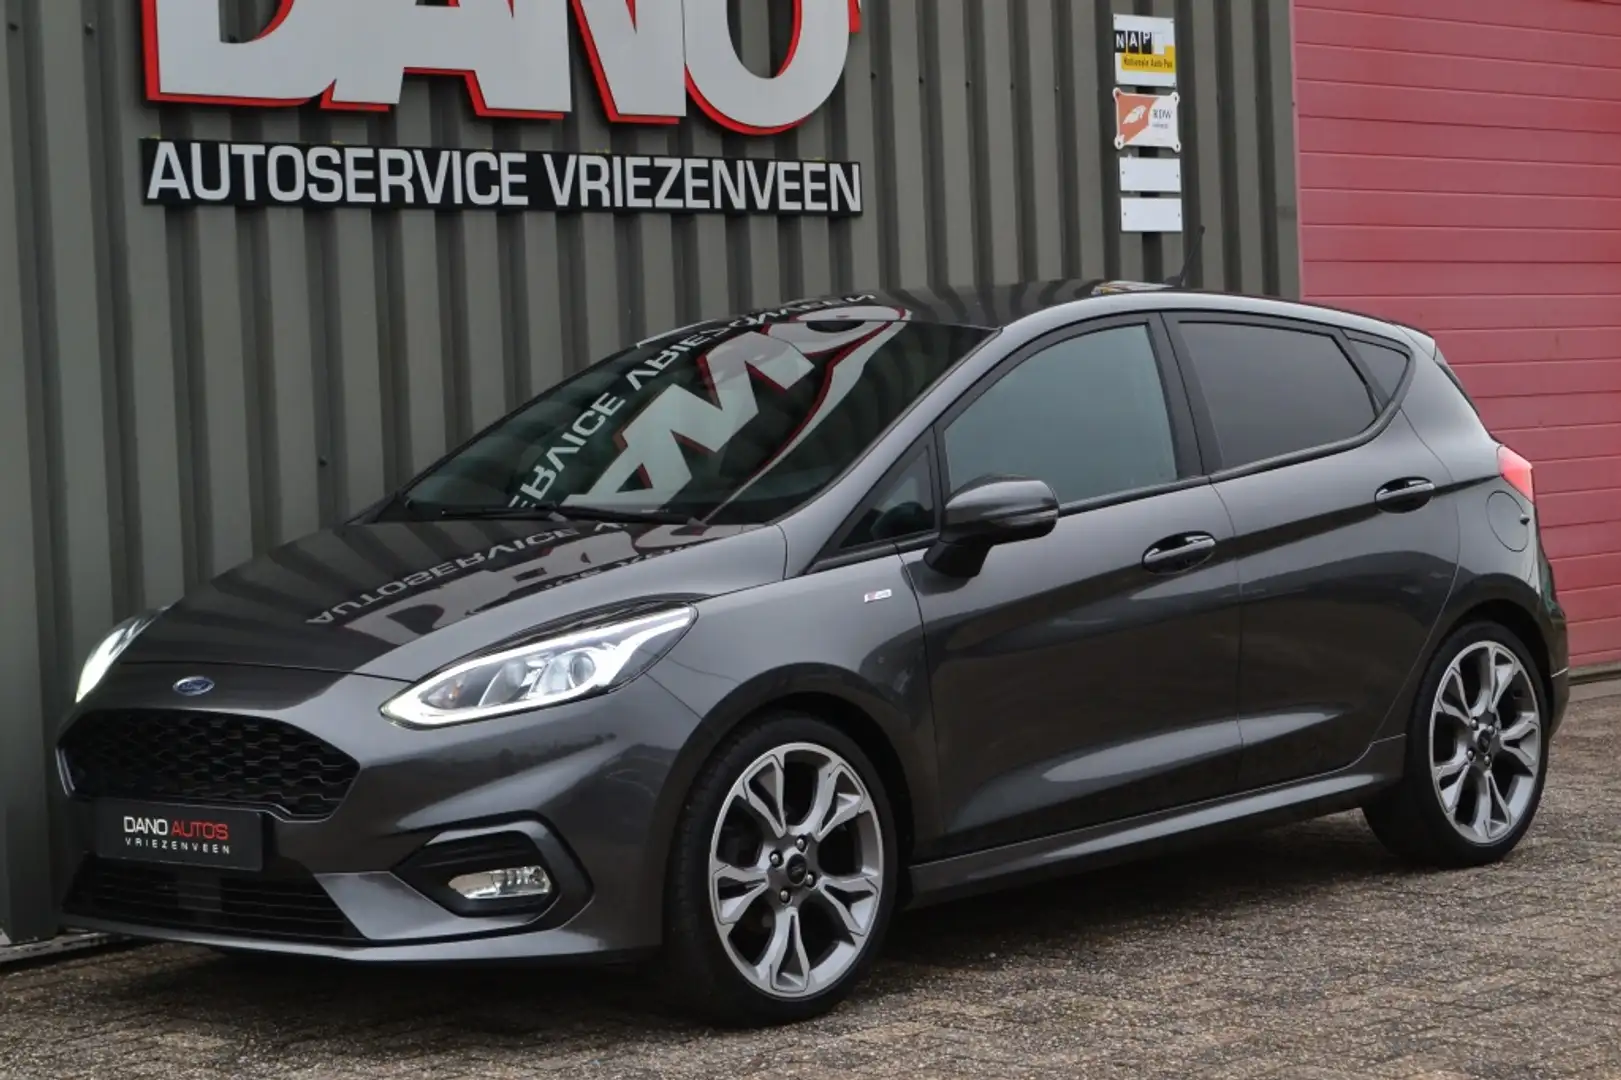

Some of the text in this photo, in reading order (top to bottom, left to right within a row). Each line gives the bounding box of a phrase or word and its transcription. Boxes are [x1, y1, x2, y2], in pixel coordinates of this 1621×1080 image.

[147, 141, 861, 212] AUTOSERVICE VRIEZENVEEN
[123, 816, 229, 840] DANO AUTOS
[125, 837, 230, 855] VRIEZENVEEN
